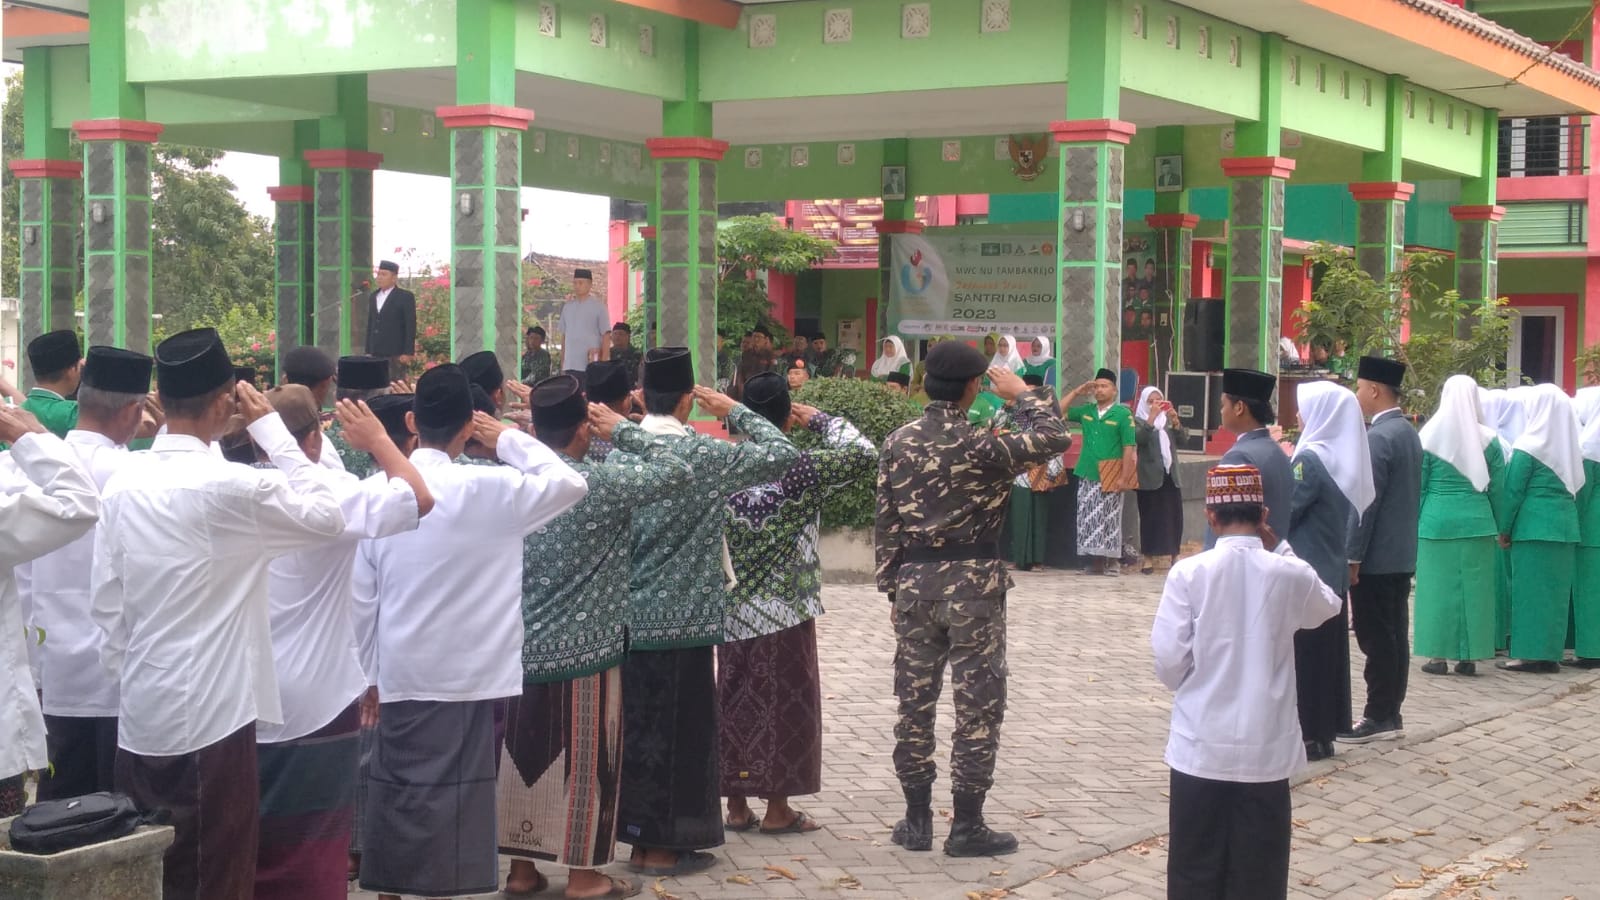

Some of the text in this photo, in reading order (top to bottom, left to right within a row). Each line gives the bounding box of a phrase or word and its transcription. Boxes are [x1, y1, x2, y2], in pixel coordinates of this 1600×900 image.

[980, 266, 993, 275] NU
[954, 293, 1005, 303] SANTRI
[952, 308, 996, 320] 2023
